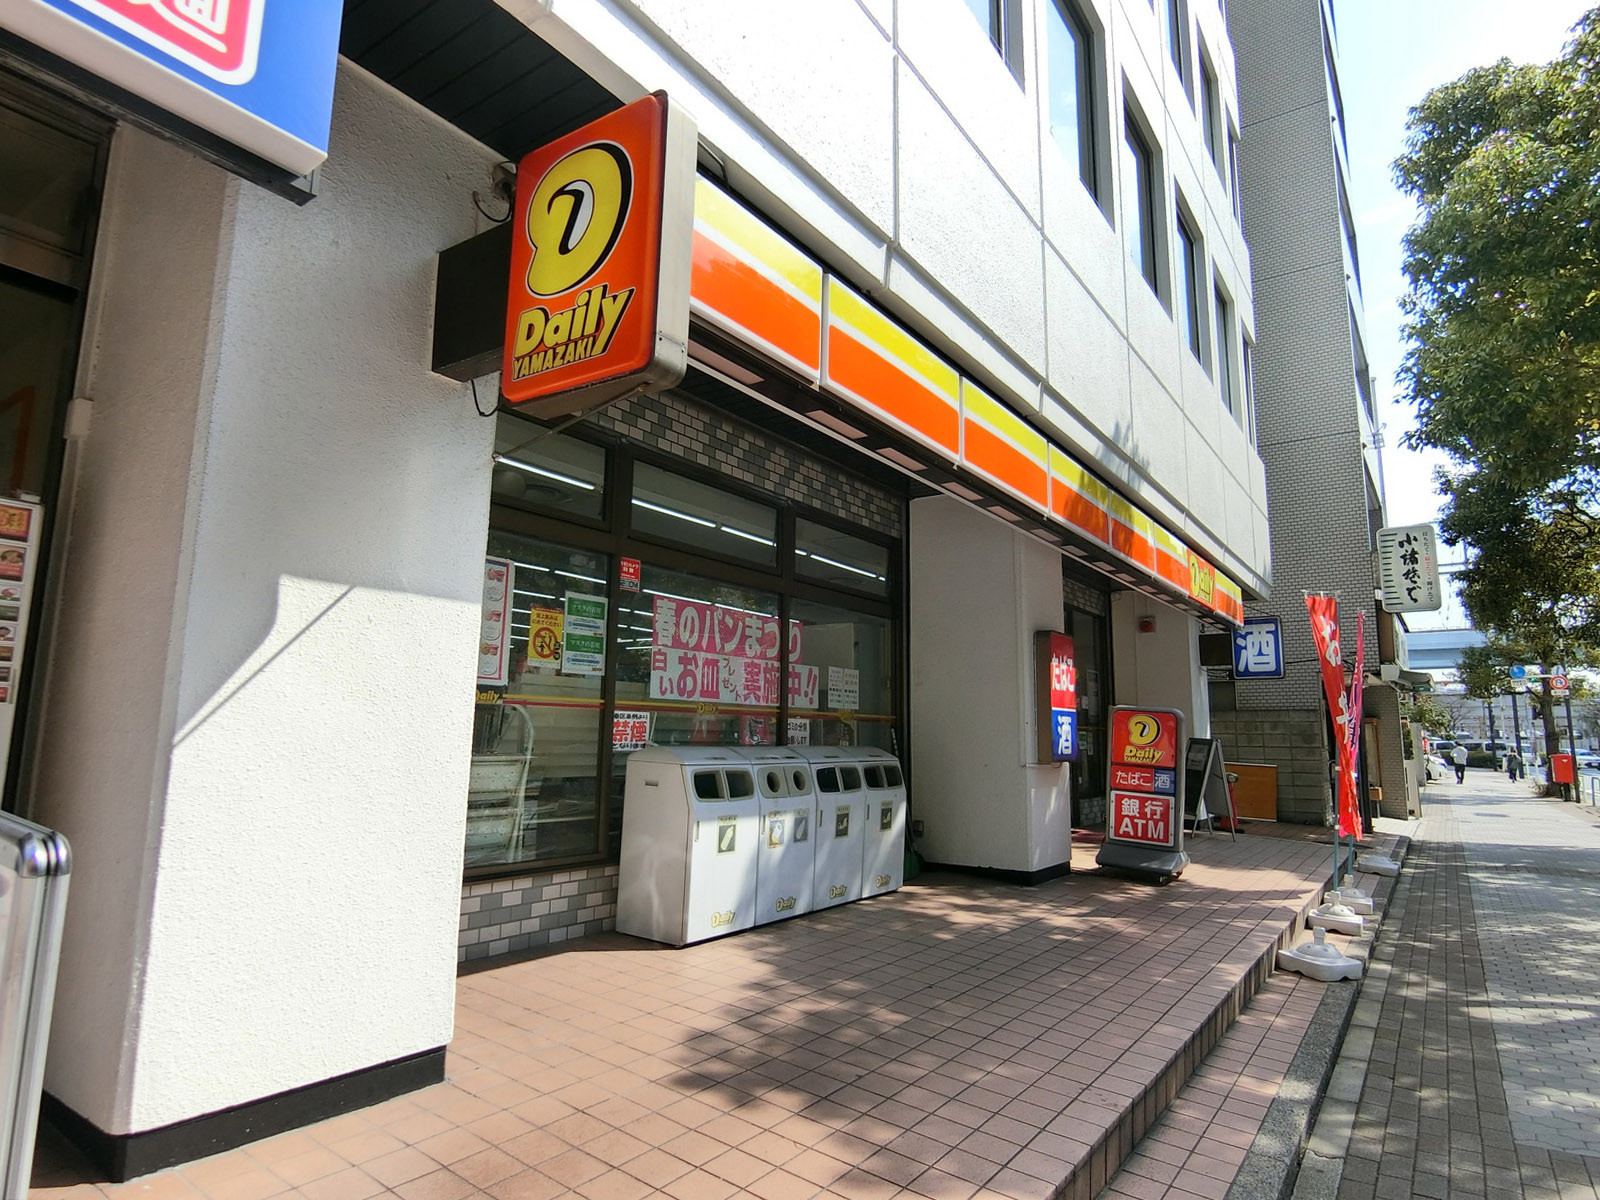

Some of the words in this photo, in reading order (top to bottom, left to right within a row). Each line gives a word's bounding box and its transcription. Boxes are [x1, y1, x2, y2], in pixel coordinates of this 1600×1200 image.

[513, 283, 635, 357] Daily
[513, 336, 593, 381] YAMAZAKI
[1189, 553, 1215, 604] Daily
[655, 599, 802, 663] 春のパンまつり
[1236, 623, 1277, 672] 酒
[1051, 653, 1075, 692] たばこ
[613, 720, 647, 742] 禁煙
[1057, 715, 1072, 755] 酒
[1124, 745, 1165, 763] Daily
[1116, 770, 1151, 786] たばこ
[1155, 772, 1170, 789] 酒
[1121, 798, 1163, 819] 銀行
[1119, 817, 1164, 839] ATM
[711, 910, 735, 928] Daily
[776, 896, 796, 912] Daily
